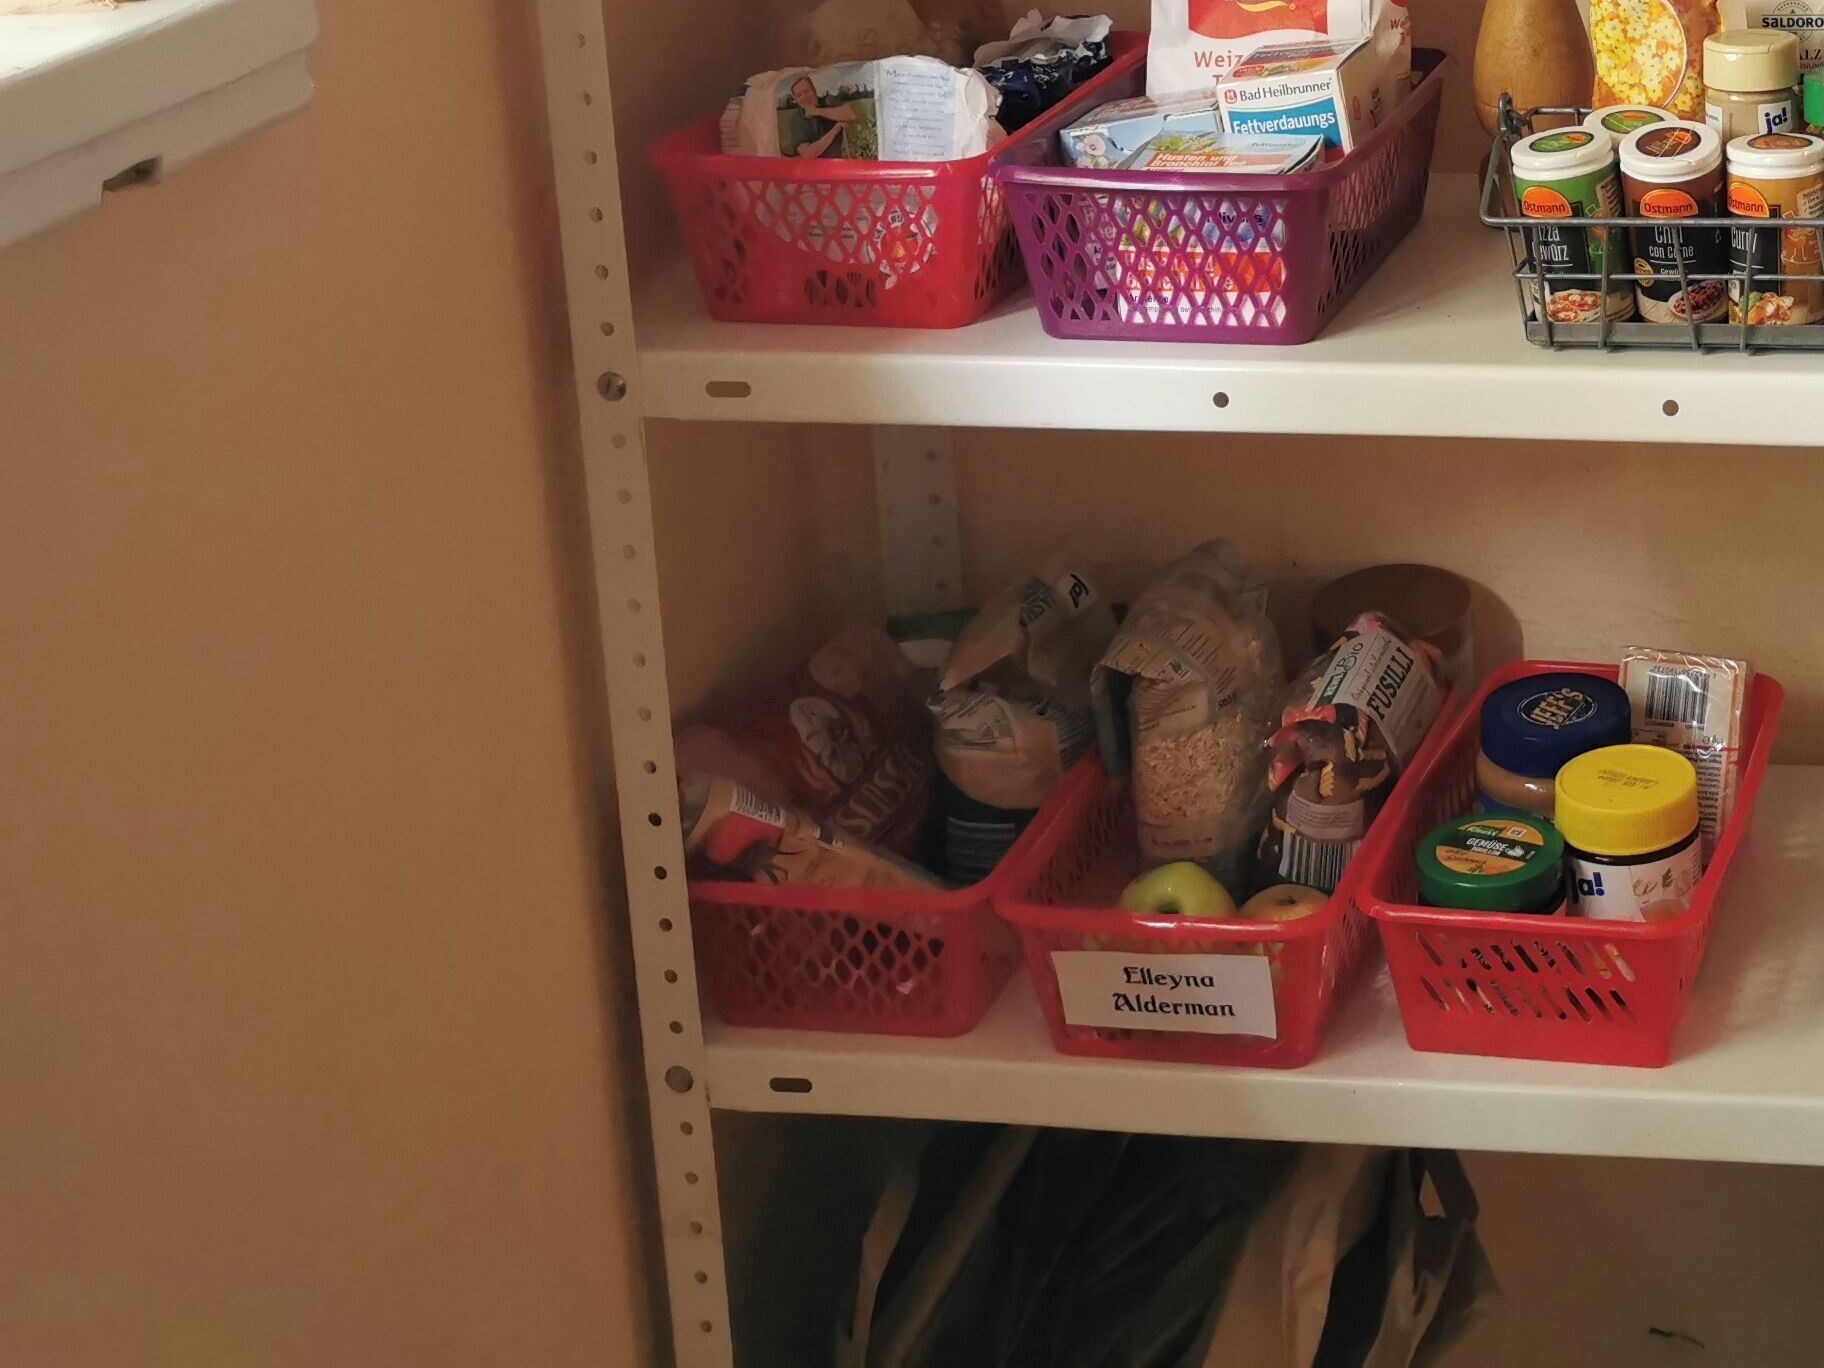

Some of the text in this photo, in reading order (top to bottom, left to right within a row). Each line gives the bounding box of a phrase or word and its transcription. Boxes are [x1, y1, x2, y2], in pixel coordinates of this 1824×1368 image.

[1239, 80, 1332, 102] Bad Heilbrunner
[1232, 110, 1336, 134] Fettverdauungs
[1764, 107, 1787, 134] ja!
[1156, 153, 1239, 163] Husten und
[1523, 201, 1566, 213] Ostmann
[1644, 202, 1693, 214] Ostmann
[1728, 197, 1764, 213] Ostmann
[1648, 245, 1666, 258] con
[1366, 646, 1414, 721] FUSILLI
[1530, 687, 1584, 730] JEFF'S
[1123, 966, 1215, 990] Elleyna
[1112, 992, 1236, 1016] Alderman
